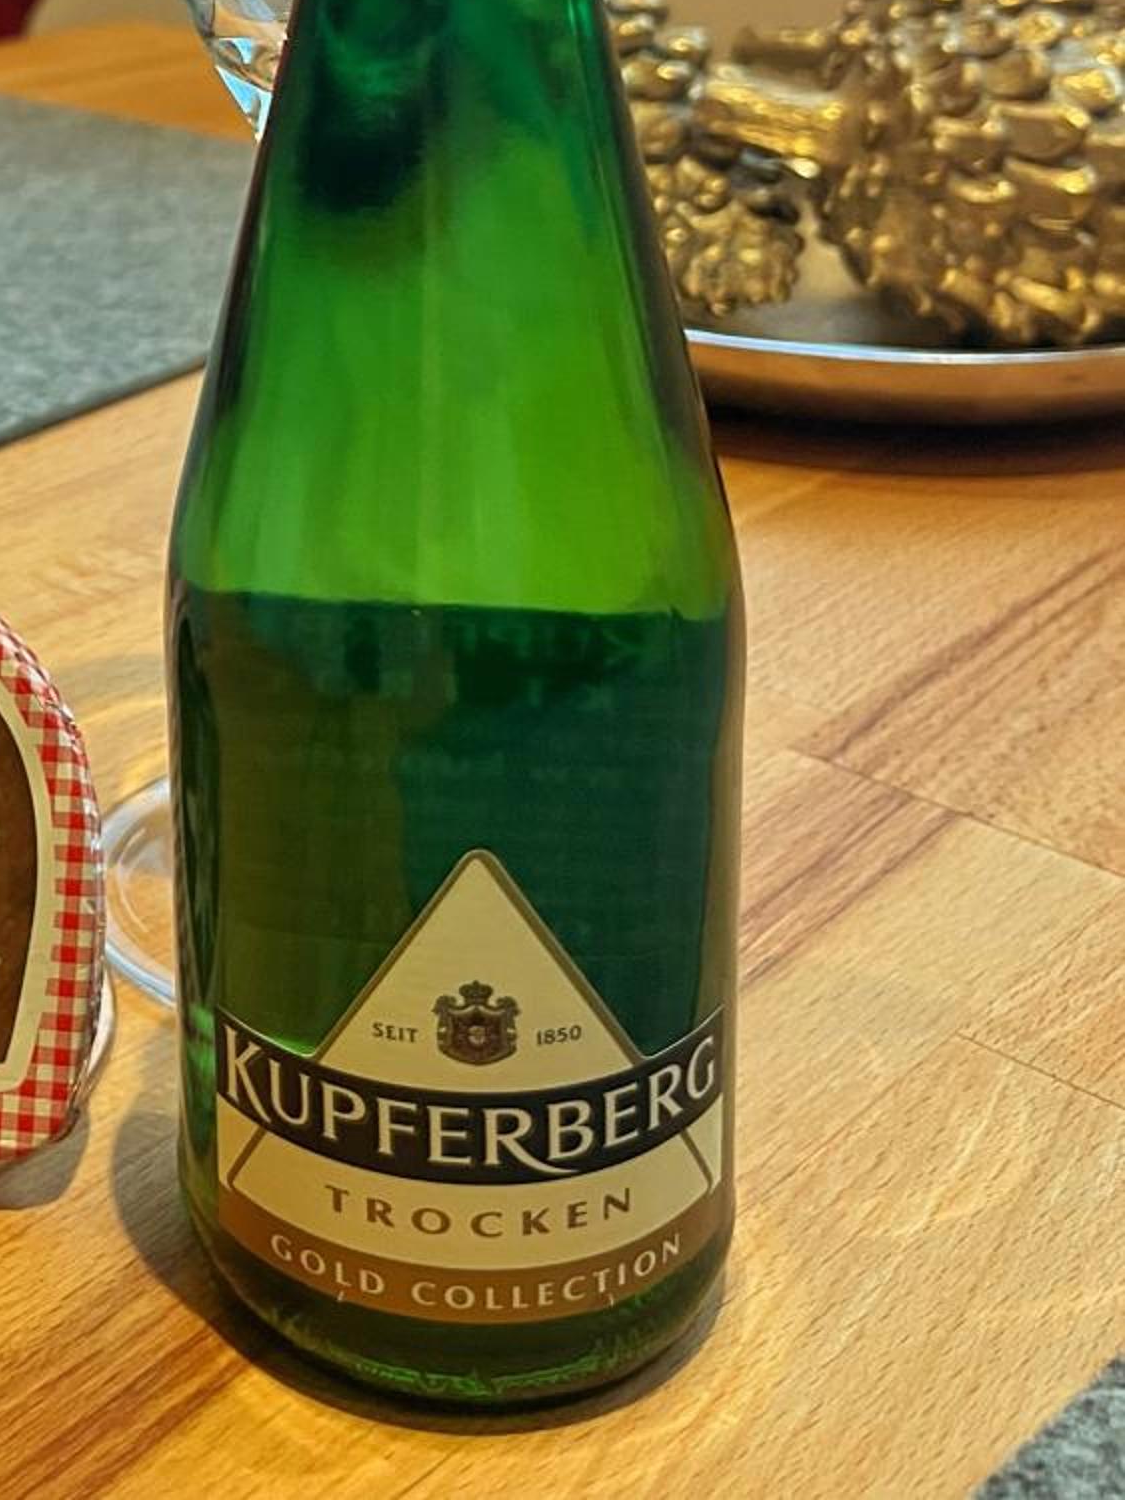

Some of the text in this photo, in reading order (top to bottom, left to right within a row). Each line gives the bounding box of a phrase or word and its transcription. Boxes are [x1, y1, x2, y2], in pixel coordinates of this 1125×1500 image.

[371, 1021, 583, 1047] SEIT 1850
[224, 1023, 716, 1175] KUPFERBERG
[324, 1185, 632, 1239] TROCKEN
[270, 1233, 681, 1310] GOLD COLLECTION
